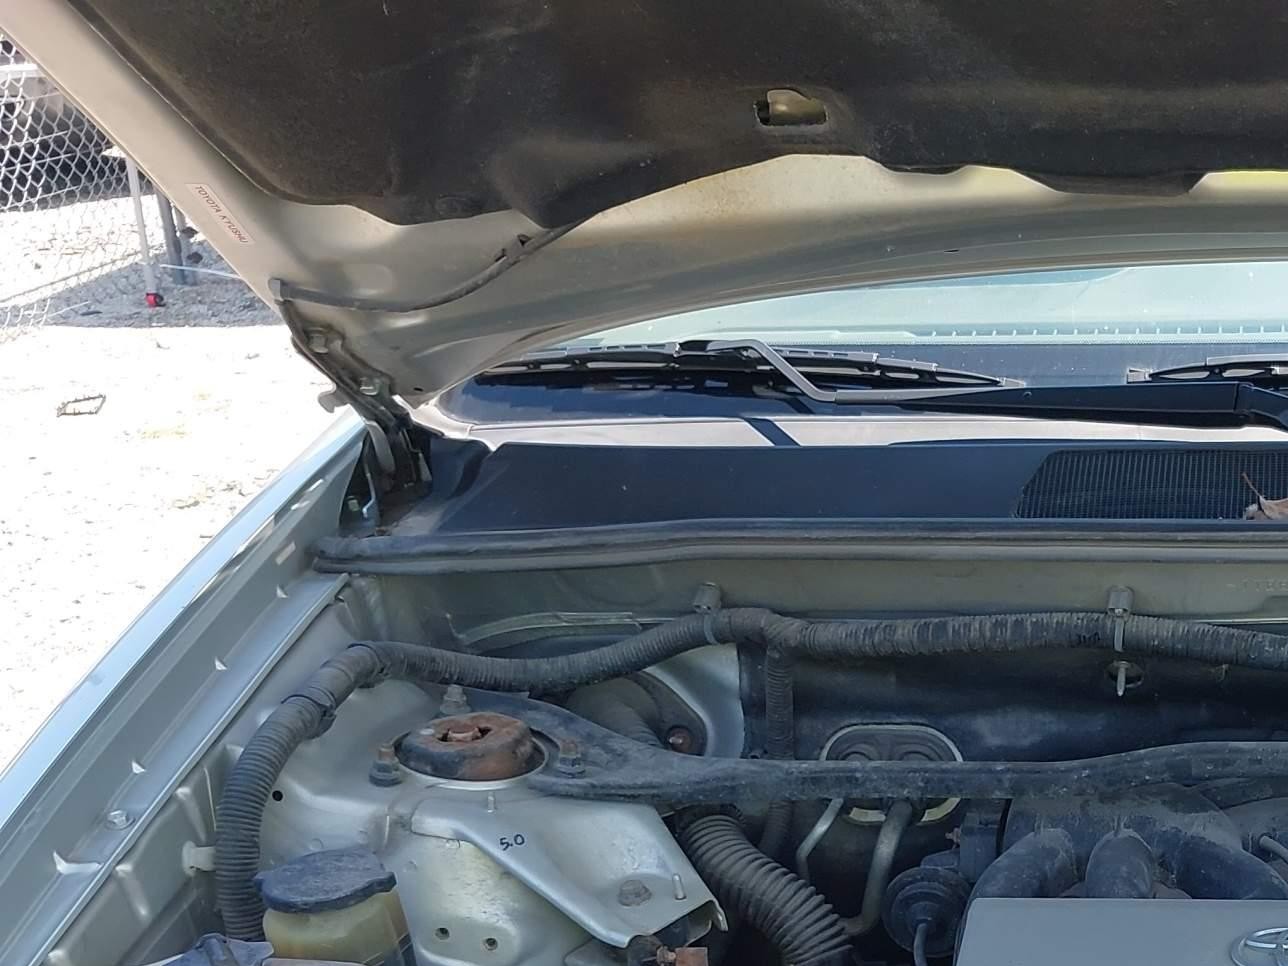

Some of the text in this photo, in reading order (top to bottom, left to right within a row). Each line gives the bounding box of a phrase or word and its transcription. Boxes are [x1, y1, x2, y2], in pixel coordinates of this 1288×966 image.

[195, 186, 249, 243] TOYOTA KYUSHU
[499, 834, 525, 851] 5.0
